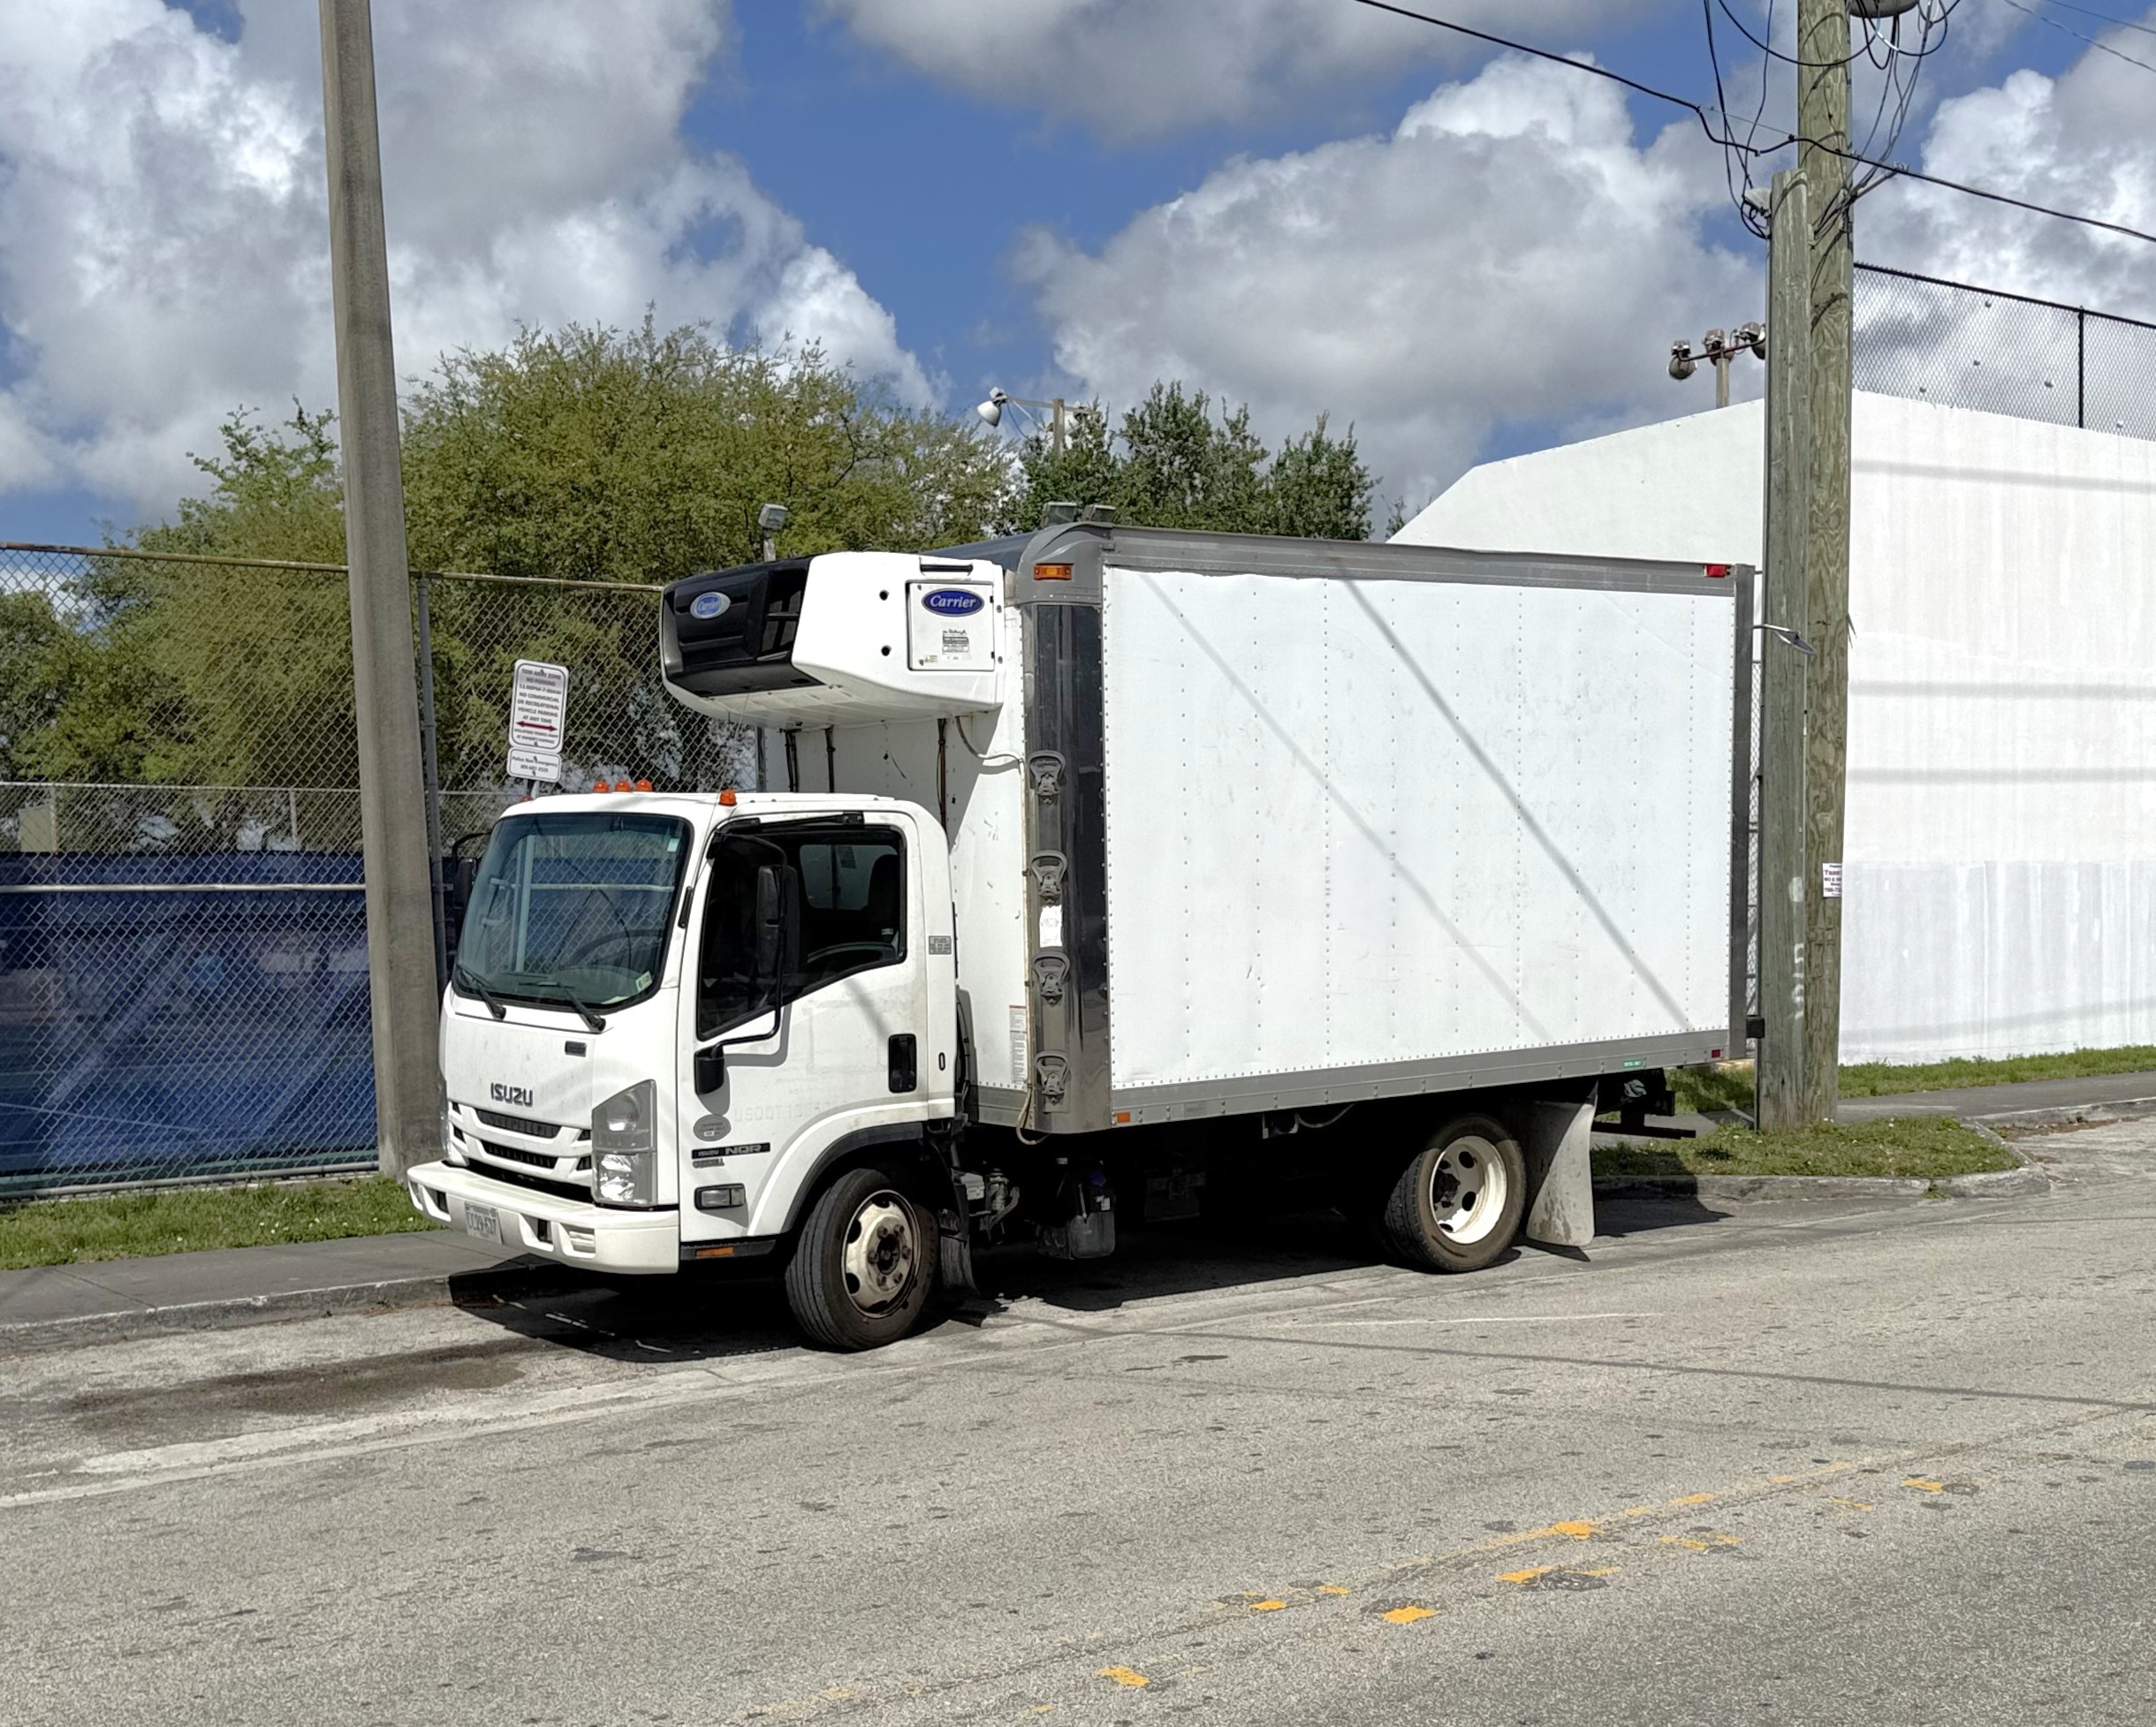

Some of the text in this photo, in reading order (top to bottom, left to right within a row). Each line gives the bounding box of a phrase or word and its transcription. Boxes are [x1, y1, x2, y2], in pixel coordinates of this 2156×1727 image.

[930, 595, 977, 608] Carrier
[528, 693, 559, 703] COMMERCIAL
[526, 701, 559, 710] RECREATIONAL
[490, 1082, 533, 1108] ISUZU
[725, 1145, 762, 1155] NQR
